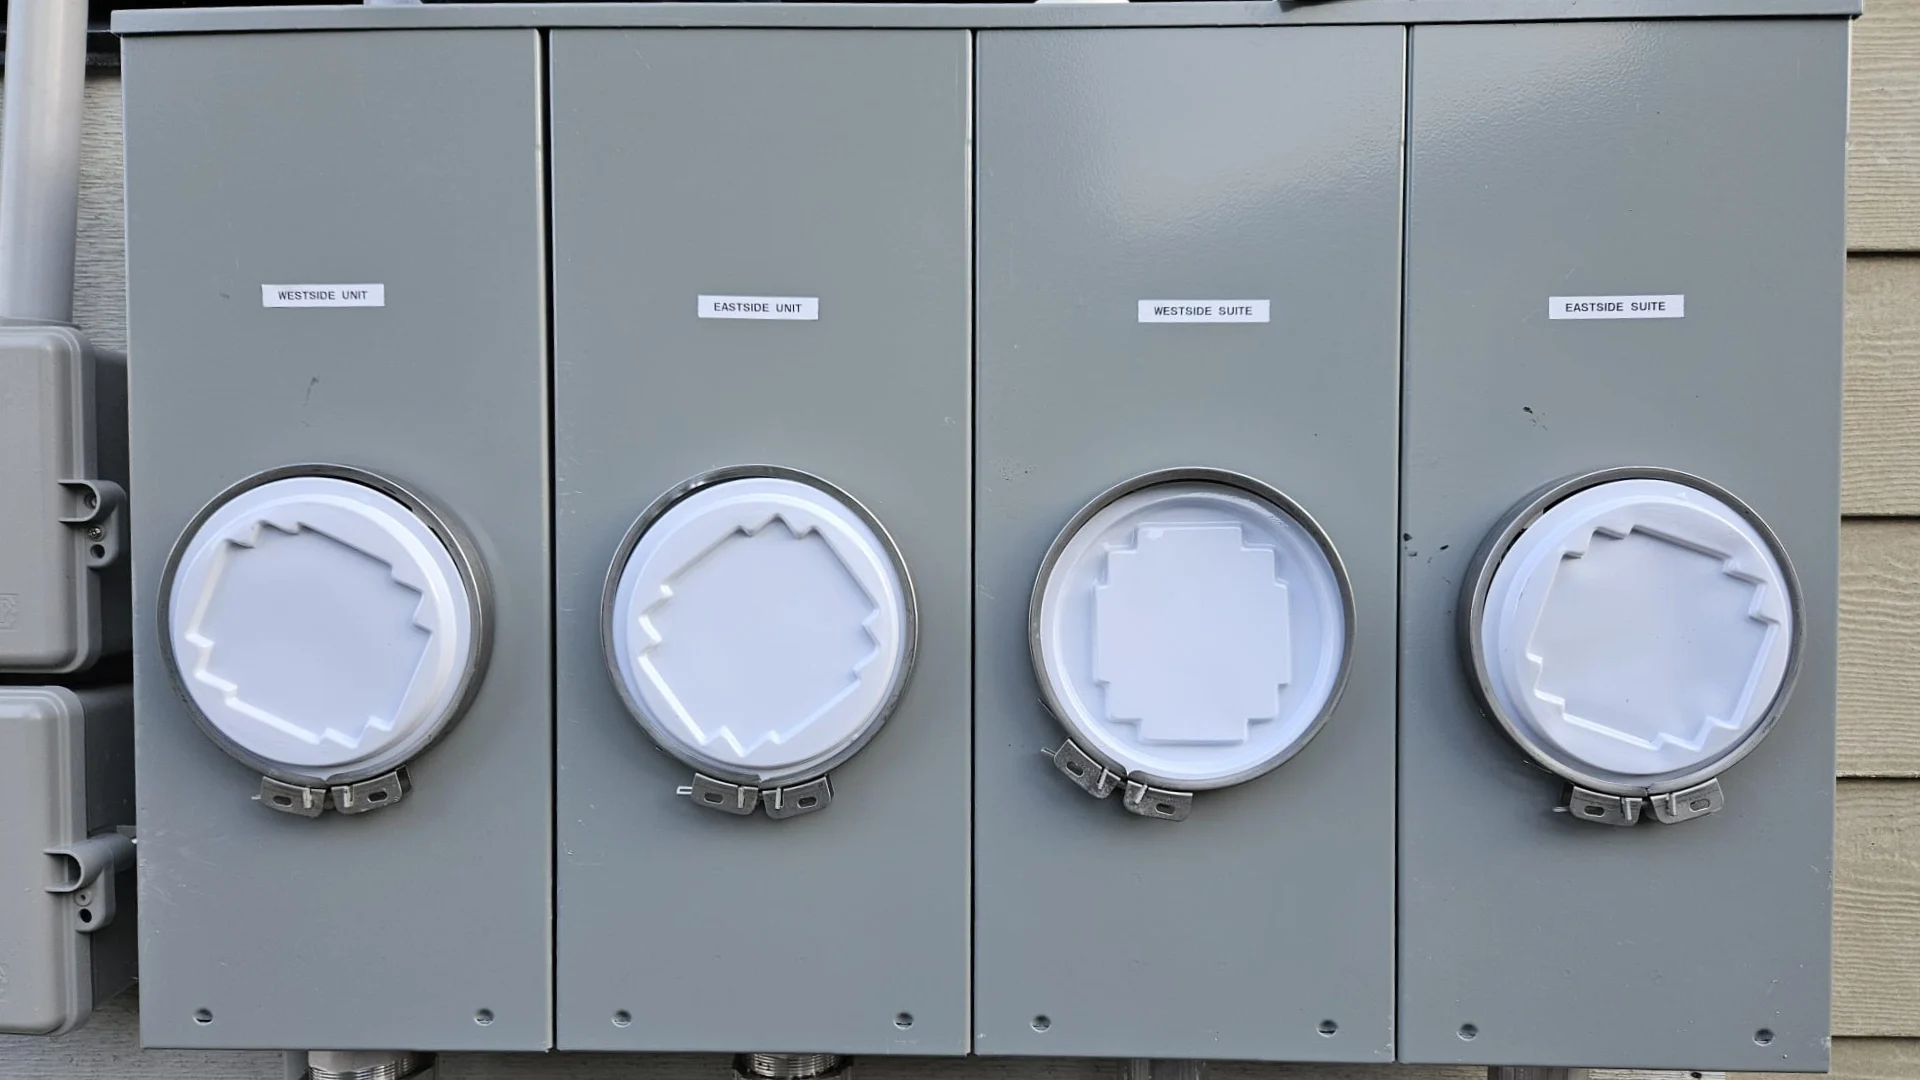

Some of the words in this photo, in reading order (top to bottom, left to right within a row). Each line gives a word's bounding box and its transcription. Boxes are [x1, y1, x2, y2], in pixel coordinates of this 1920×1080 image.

[278, 291, 335, 300] WESTSIDE
[342, 291, 367, 300] UNIT
[714, 303, 769, 312] EASTSIDE
[776, 303, 802, 313] UNIT
[1154, 306, 1212, 316] WESTSIDE
[1218, 306, 1253, 316] SUITE
[1565, 302, 1624, 312] EASTSIDE
[1630, 301, 1666, 311] SUITE
